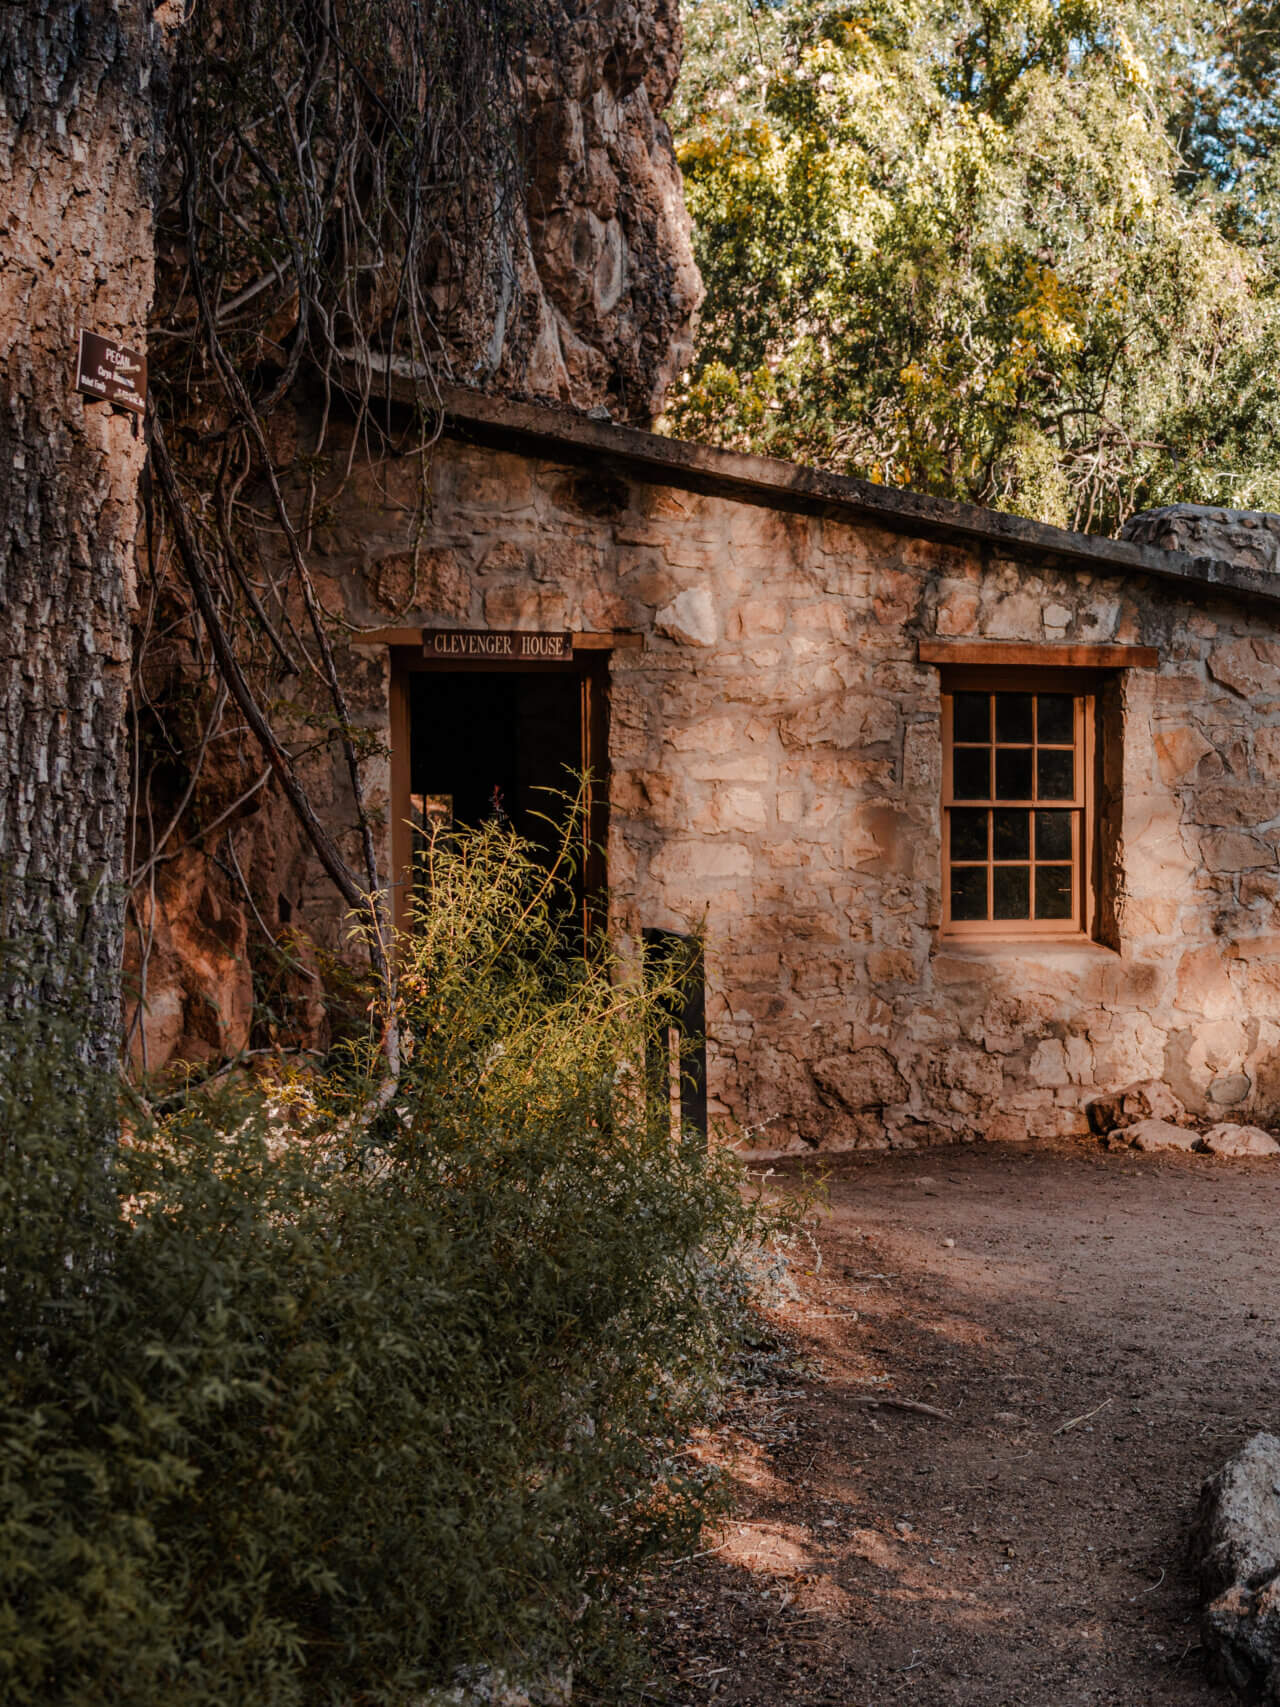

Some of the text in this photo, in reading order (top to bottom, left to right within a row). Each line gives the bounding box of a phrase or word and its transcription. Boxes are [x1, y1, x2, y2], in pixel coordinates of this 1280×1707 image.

[105, 347, 131, 369] PECAN
[434, 634, 564, 656] CLEVENGER HOUSE
